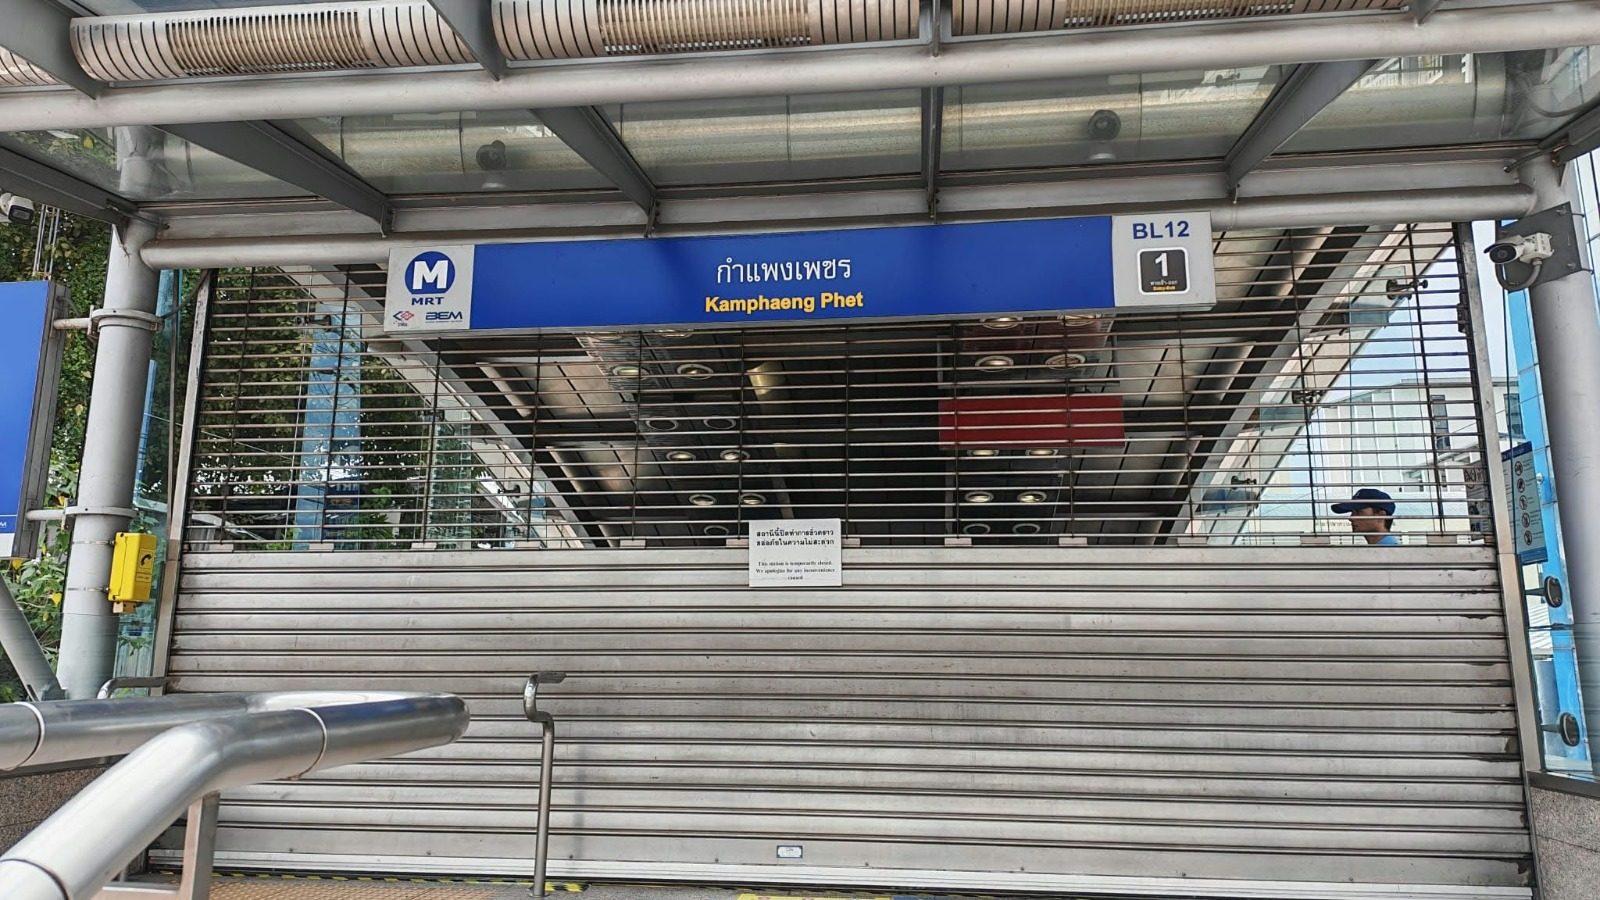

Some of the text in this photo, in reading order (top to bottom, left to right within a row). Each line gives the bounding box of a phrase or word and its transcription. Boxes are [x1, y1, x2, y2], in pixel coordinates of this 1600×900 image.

[1132, 220, 1190, 240] BL12
[413, 260, 448, 289] M
[717, 257, 851, 284] กำแพงเพชร
[1155, 252, 1168, 277] 1
[411, 296, 445, 306] MRT
[705, 291, 864, 315] Kamphaeng Phet
[425, 311, 463, 320] BEM
